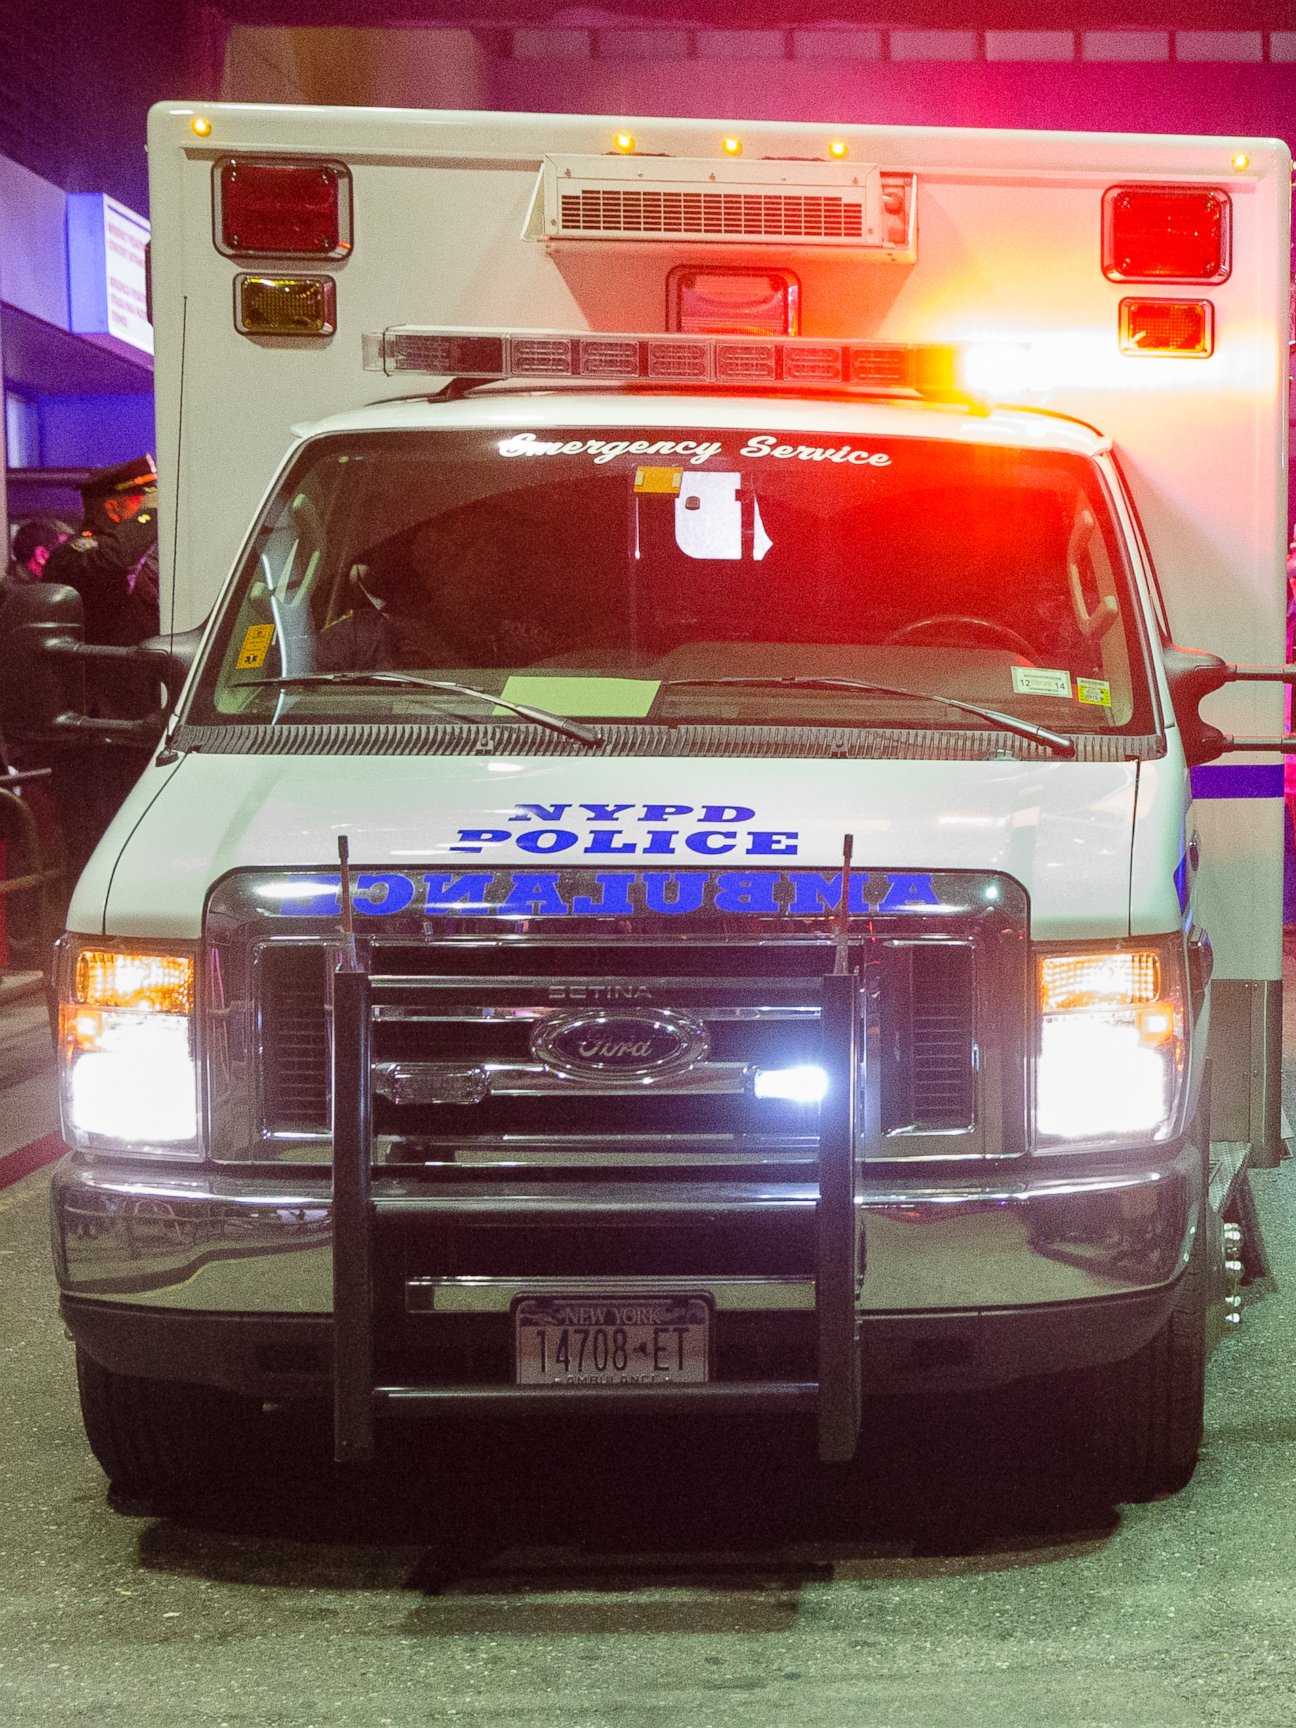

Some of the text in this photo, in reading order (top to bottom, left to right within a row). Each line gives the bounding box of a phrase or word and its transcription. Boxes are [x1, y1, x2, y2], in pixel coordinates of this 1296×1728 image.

[498, 432, 892, 467] Emergency Service
[1020, 679, 1031, 687] 12
[1055, 682, 1065, 690] 14
[508, 804, 756, 823] NYPD
[449, 829, 799, 855] POLICE
[549, 985, 652, 999] SETINA
[577, 1032, 653, 1057] Ford
[566, 1307, 662, 1324] NEW YORK
[537, 1327, 690, 1373] 14708 ET
